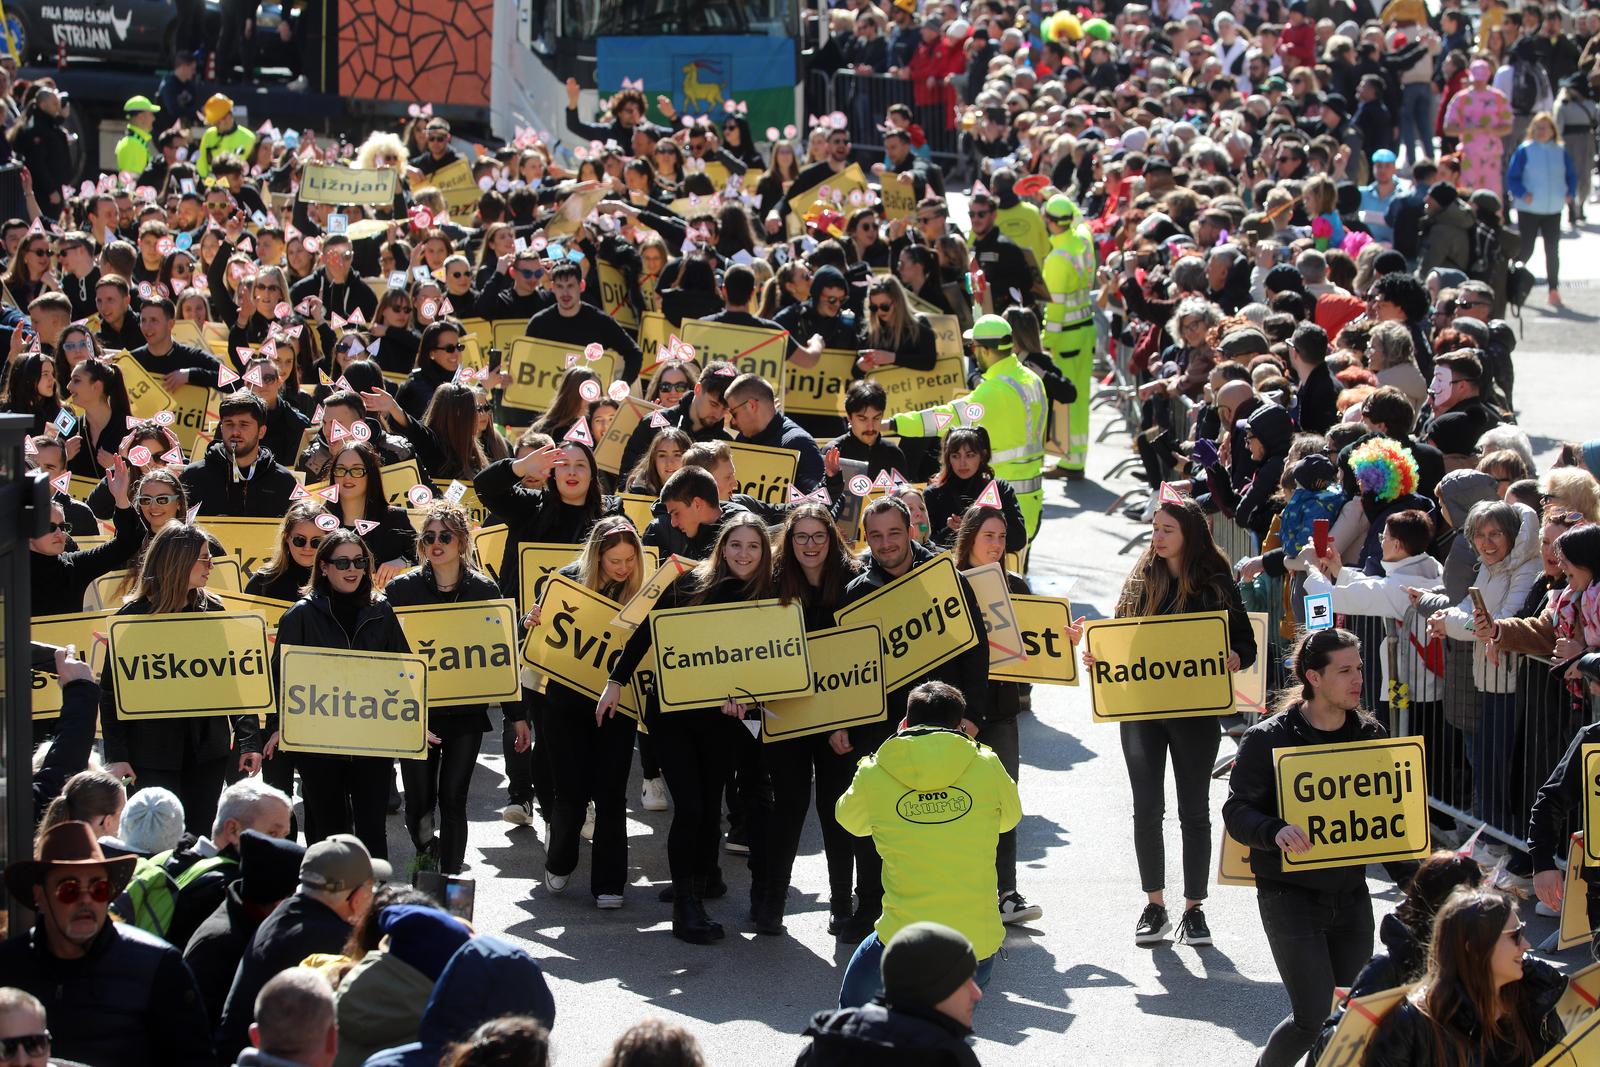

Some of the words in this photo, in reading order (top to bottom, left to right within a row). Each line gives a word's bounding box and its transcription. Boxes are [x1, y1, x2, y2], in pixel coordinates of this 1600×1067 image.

[52, 24, 112, 50] ISTRIJAN
[309, 176, 388, 194] Ližnjan
[916, 371, 959, 389] Petar
[159, 413, 172, 423] 50
[173, 406, 202, 429] ići
[968, 407, 980, 417] 50
[354, 426, 367, 437] 50
[130, 449, 149, 462] STOP
[853, 479, 868, 492] 50
[662, 637, 802, 670] Čambarelići
[118, 649, 264, 681] Viškovići
[1095, 650, 1226, 684] Radovani
[813, 660, 878, 694] kovići
[287, 684, 420, 722] Skitača
[1293, 761, 1413, 804] Gorenji
[903, 796, 967, 817] kurti
[918, 791, 948, 802] FOTO
[1307, 810, 1405, 846] Rabac
